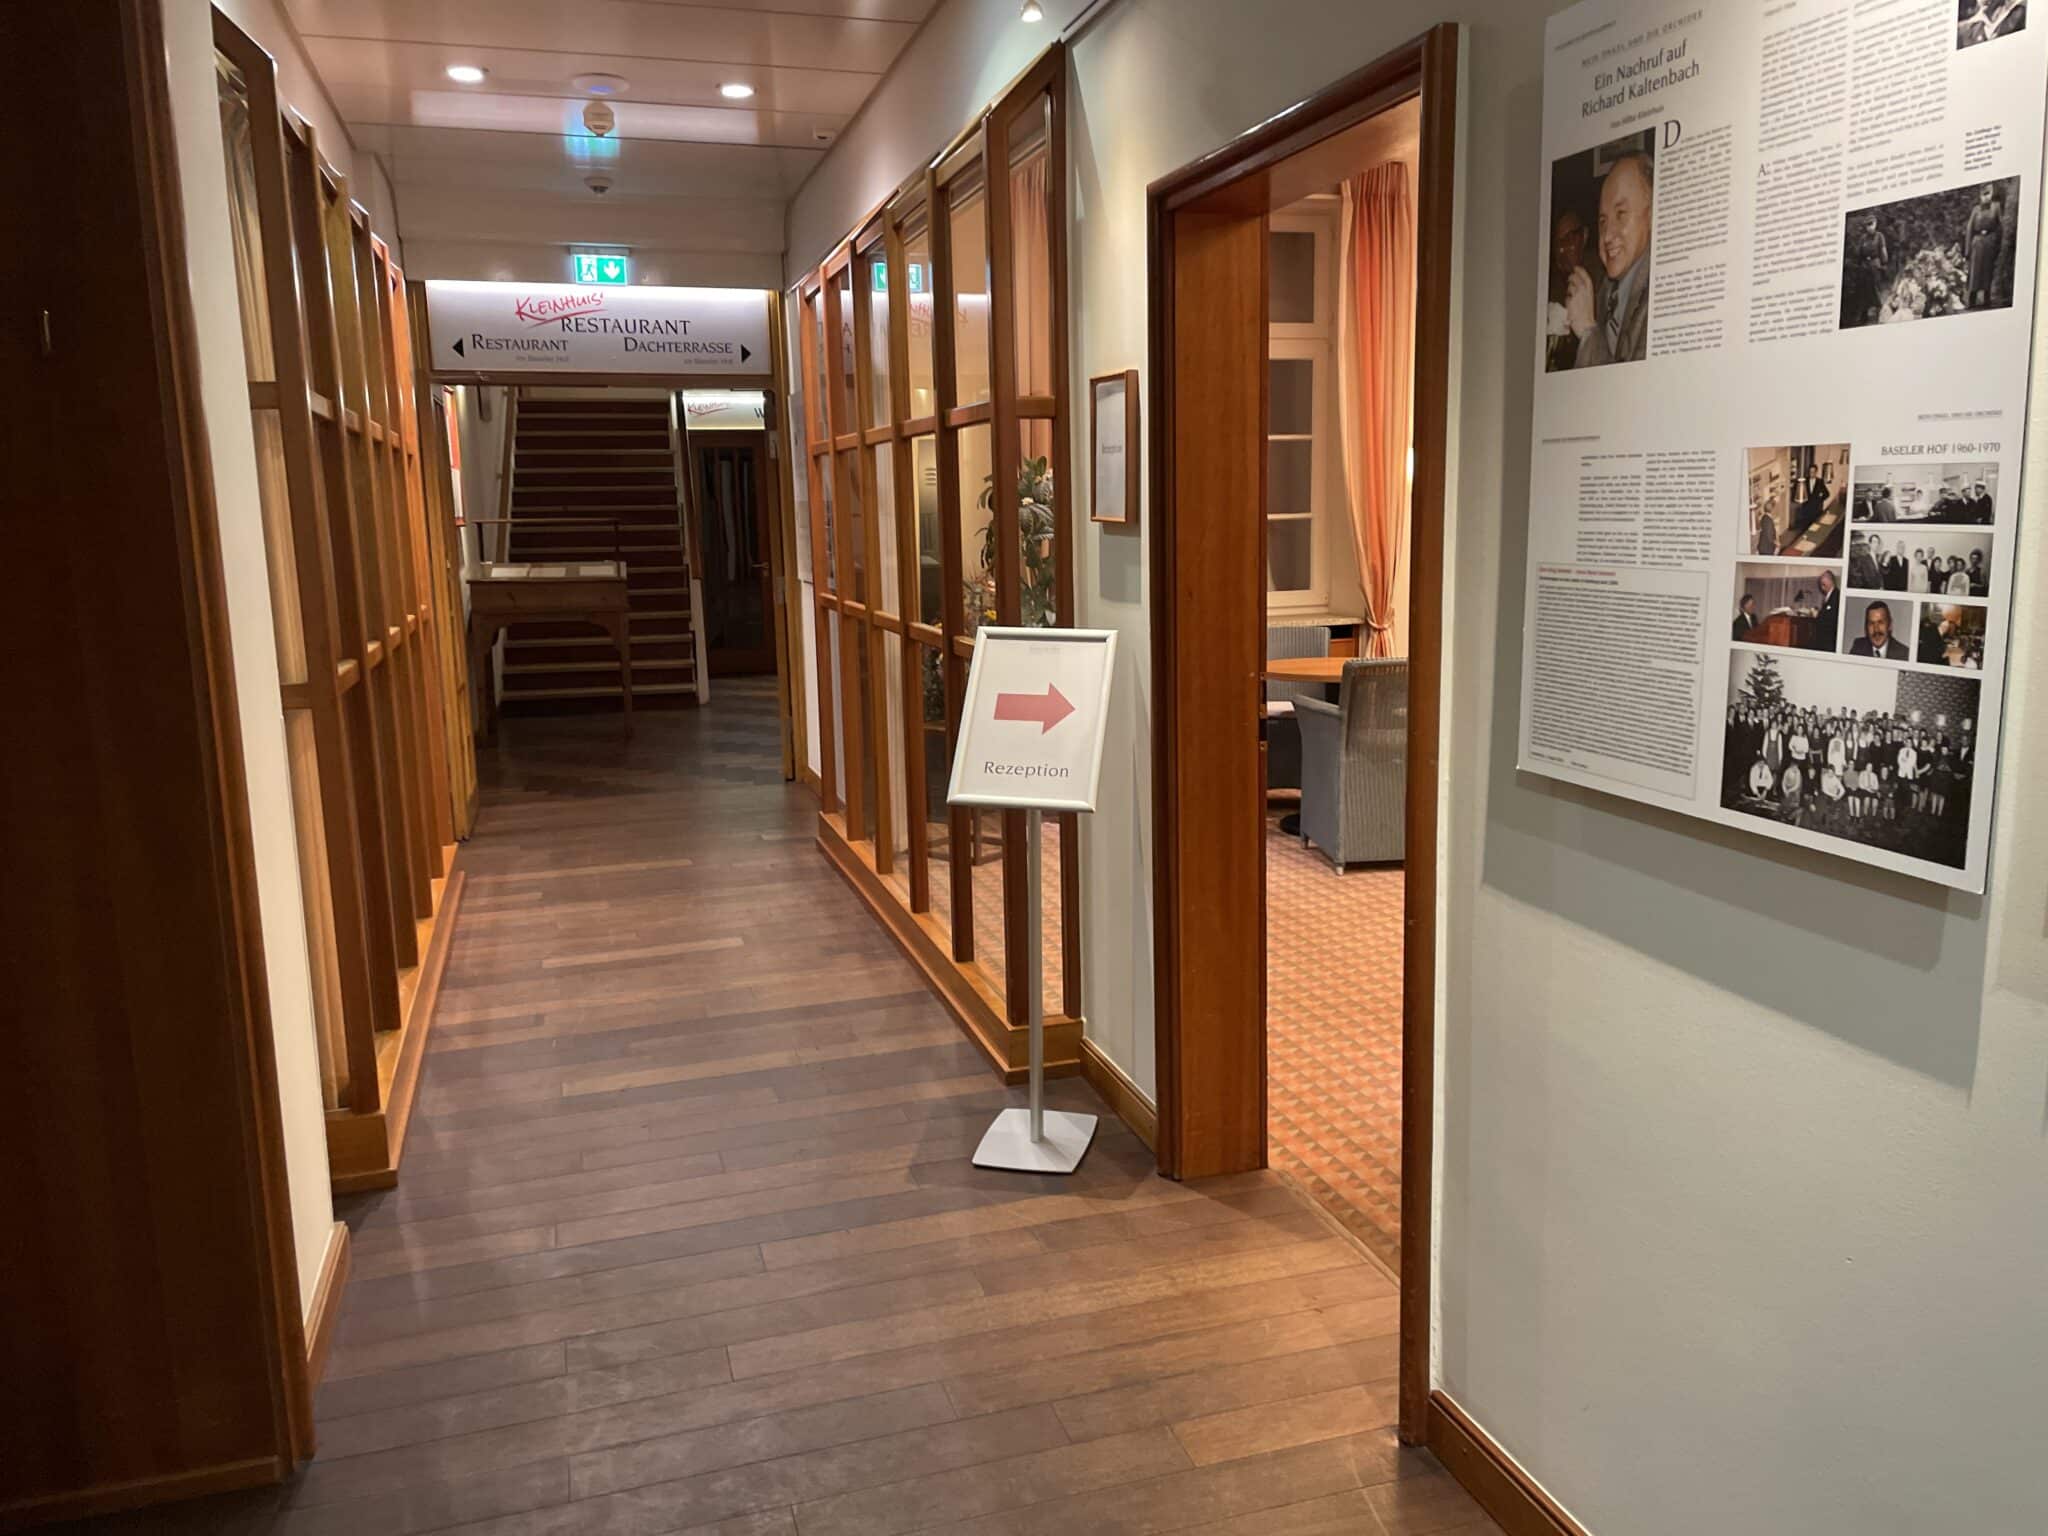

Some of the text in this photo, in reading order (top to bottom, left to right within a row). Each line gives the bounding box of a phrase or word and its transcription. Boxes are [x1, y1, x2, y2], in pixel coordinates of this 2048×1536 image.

[1594, 38, 1687, 91] Ein Nachruf auf
[1582, 86, 1625, 118] Richard
[1628, 59, 1700, 100] Kaltenbach
[561, 316, 690, 335] RESTAURANT
[1881, 442, 2001, 456] BASELER HOF 1960-1970
[984, 761, 1069, 778] Rezeption
